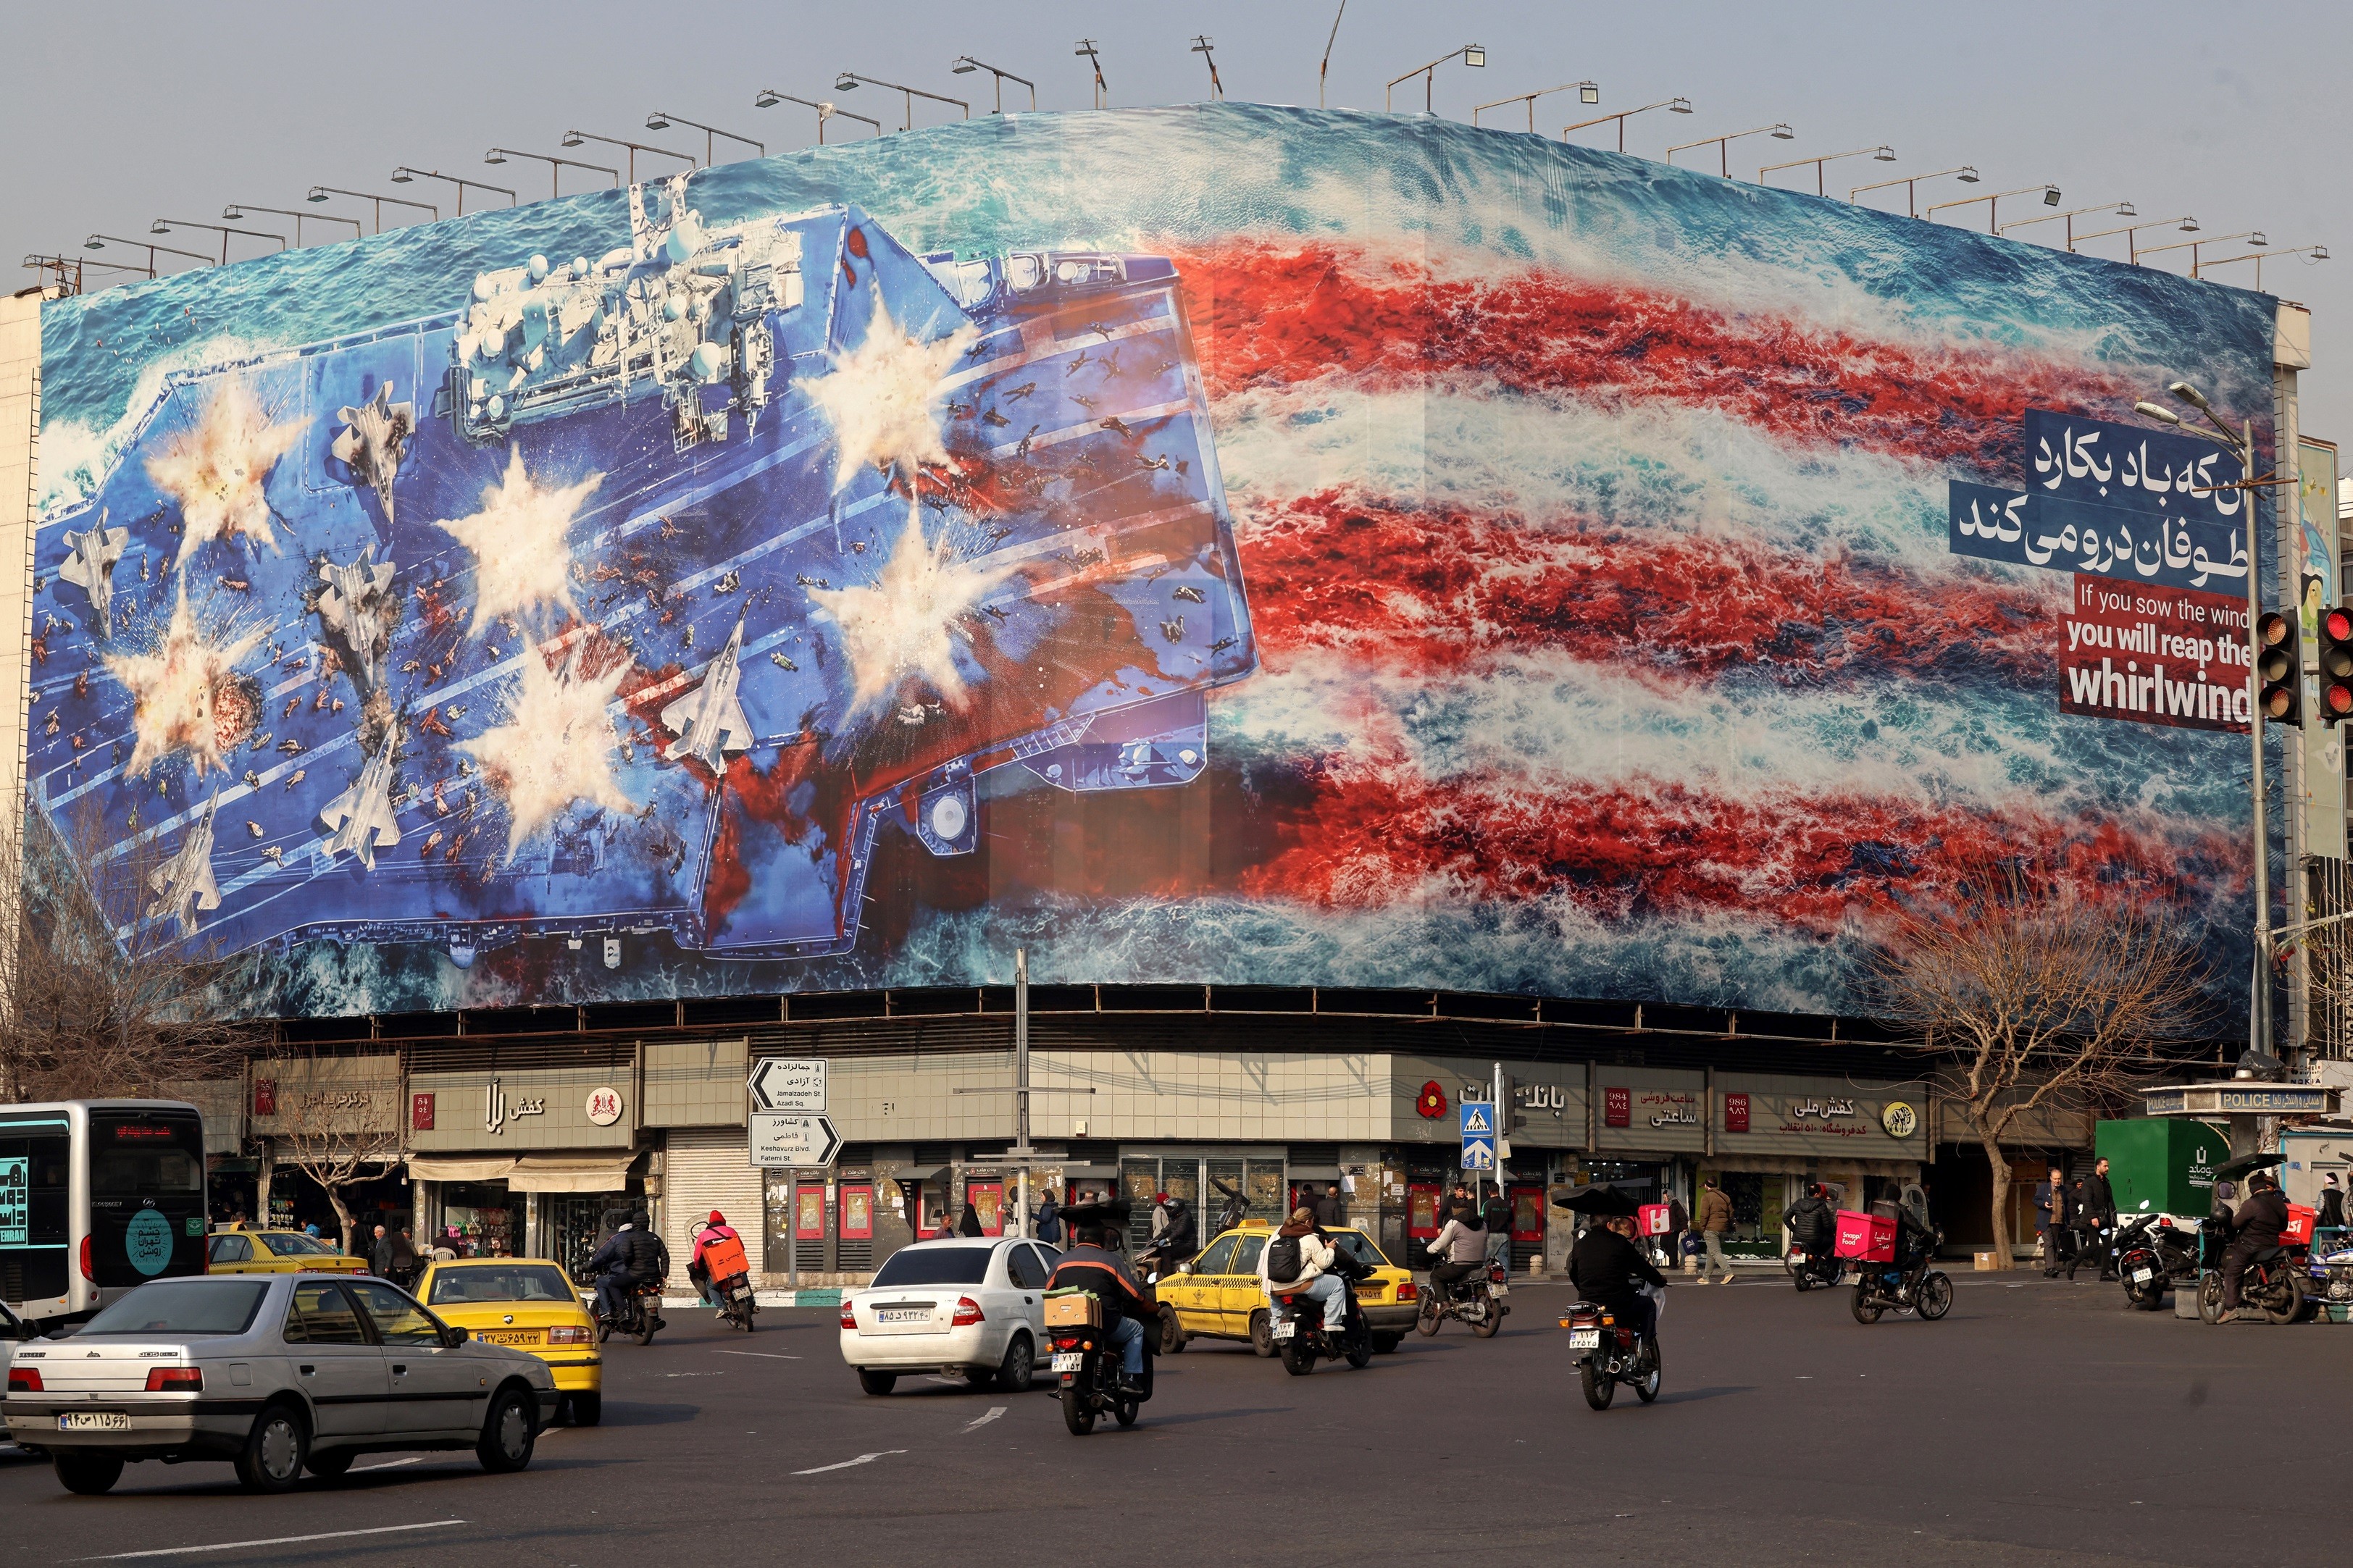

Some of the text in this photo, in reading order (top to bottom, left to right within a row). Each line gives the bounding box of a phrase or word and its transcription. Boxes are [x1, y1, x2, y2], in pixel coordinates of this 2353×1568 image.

[2035, 427, 2112, 498] بکارد
[2122, 440, 2173, 508] باد
[2136, 517, 2249, 587] طوفان
[2081, 584, 2250, 629] If you sow the wind
[2066, 620, 2251, 669] you will reap the
[2068, 656, 2252, 724] whirlwind
[777, 1062, 811, 1072] جمالزاده
[787, 1077, 811, 1087] آزادی
[417, 1097, 428, 1105] 54
[1608, 1092, 1627, 1101] 984
[2149, 1096, 2166, 1110] POLICE
[2223, 1094, 2270, 1108] POLICE
[509, 1097, 545, 1120] کفش
[1794, 1097, 1854, 1119] کفش ملی
[772, 1118, 799, 1127] کشاورز
[1650, 1108, 1697, 1127] ساعتی
[1779, 1123, 1803, 1134] انقلاب
[773, 1132, 799, 1141] فاطمی
[0, 1229, 25, 1242] EHRAN
[138, 1247, 162, 1257] روشن
